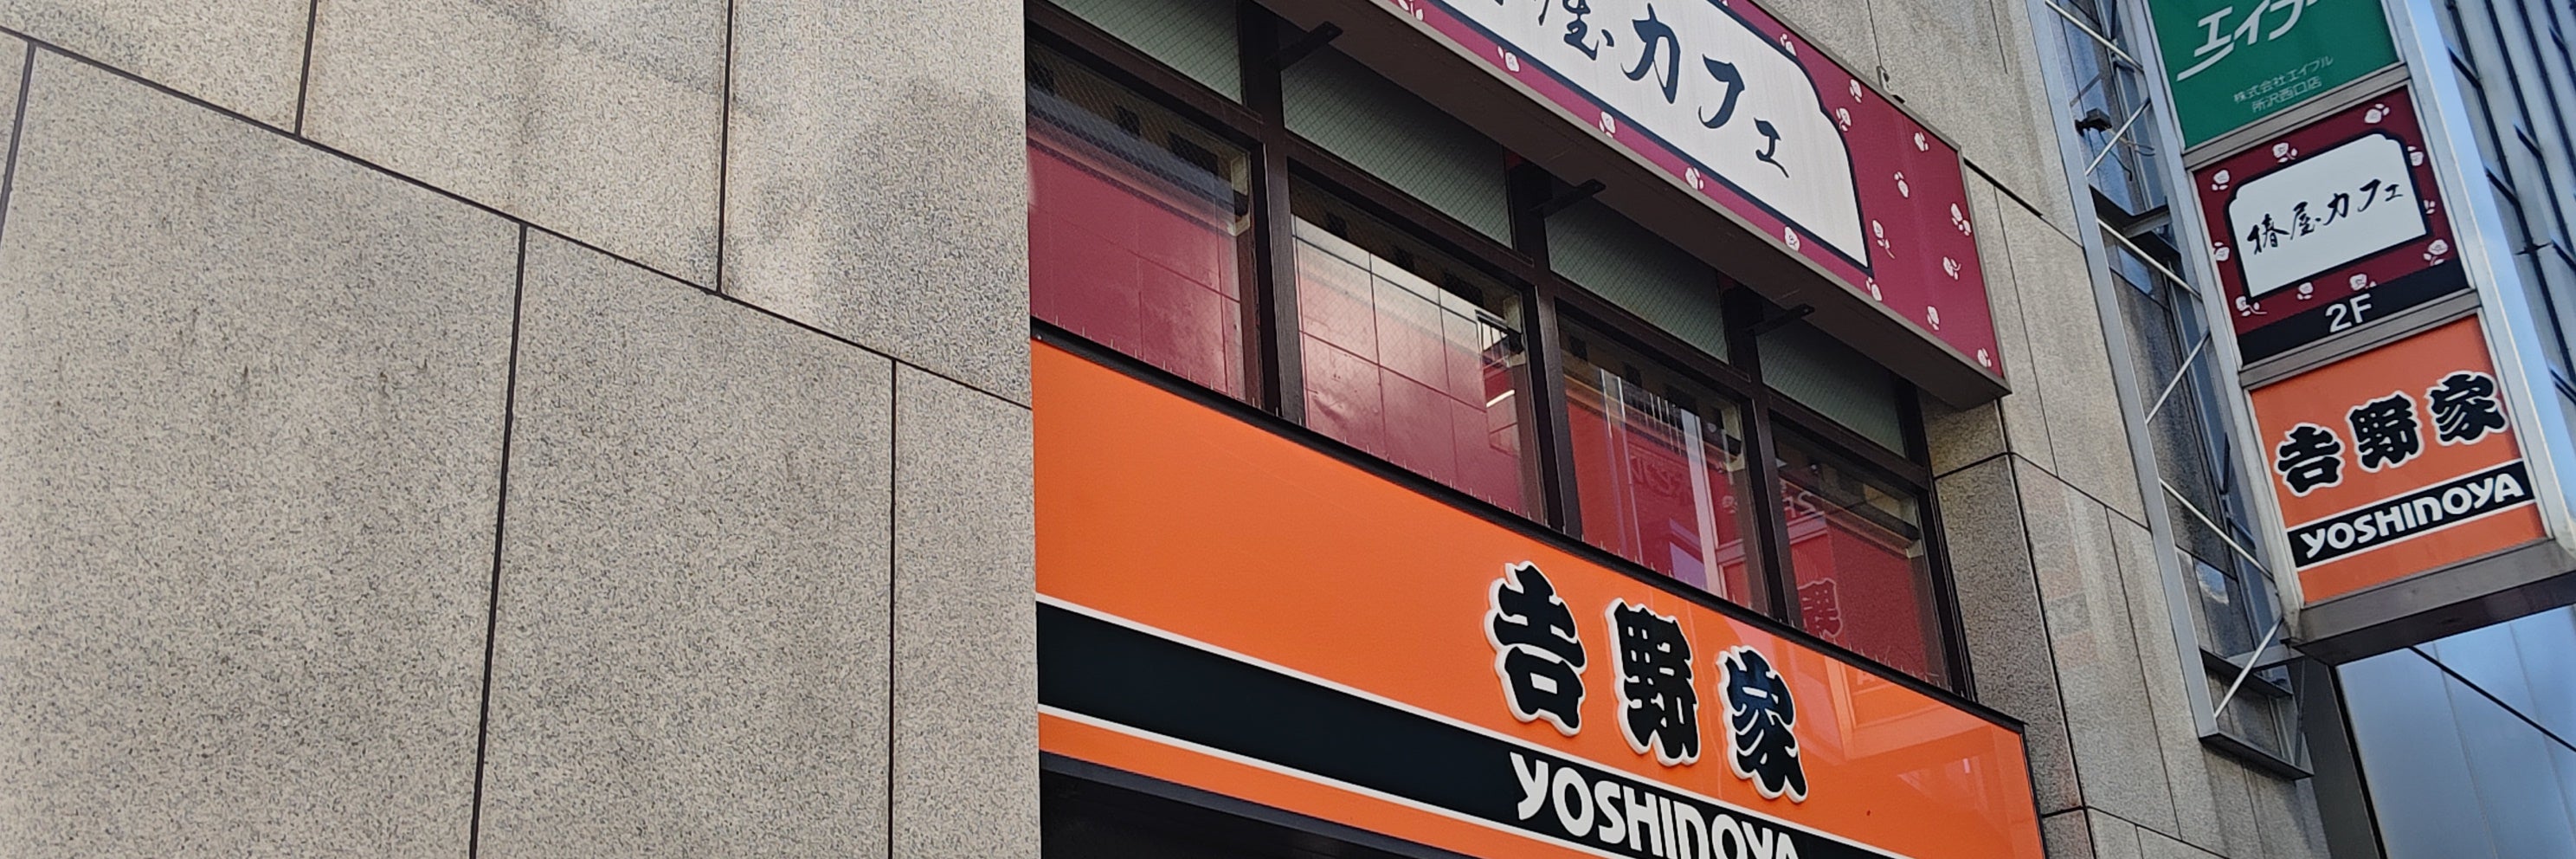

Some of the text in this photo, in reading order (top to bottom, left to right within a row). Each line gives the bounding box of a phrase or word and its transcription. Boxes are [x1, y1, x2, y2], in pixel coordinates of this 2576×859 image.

[1493, 0, 1789, 178] 屋カフェ
[2251, 75, 2322, 113] 所沢西口店
[2325, 293, 2373, 333] 2F
[2275, 371, 2508, 497] 吉野家
[2300, 473, 2524, 559] YOSHINOYA
[1484, 561, 1809, 804] 吉野家
